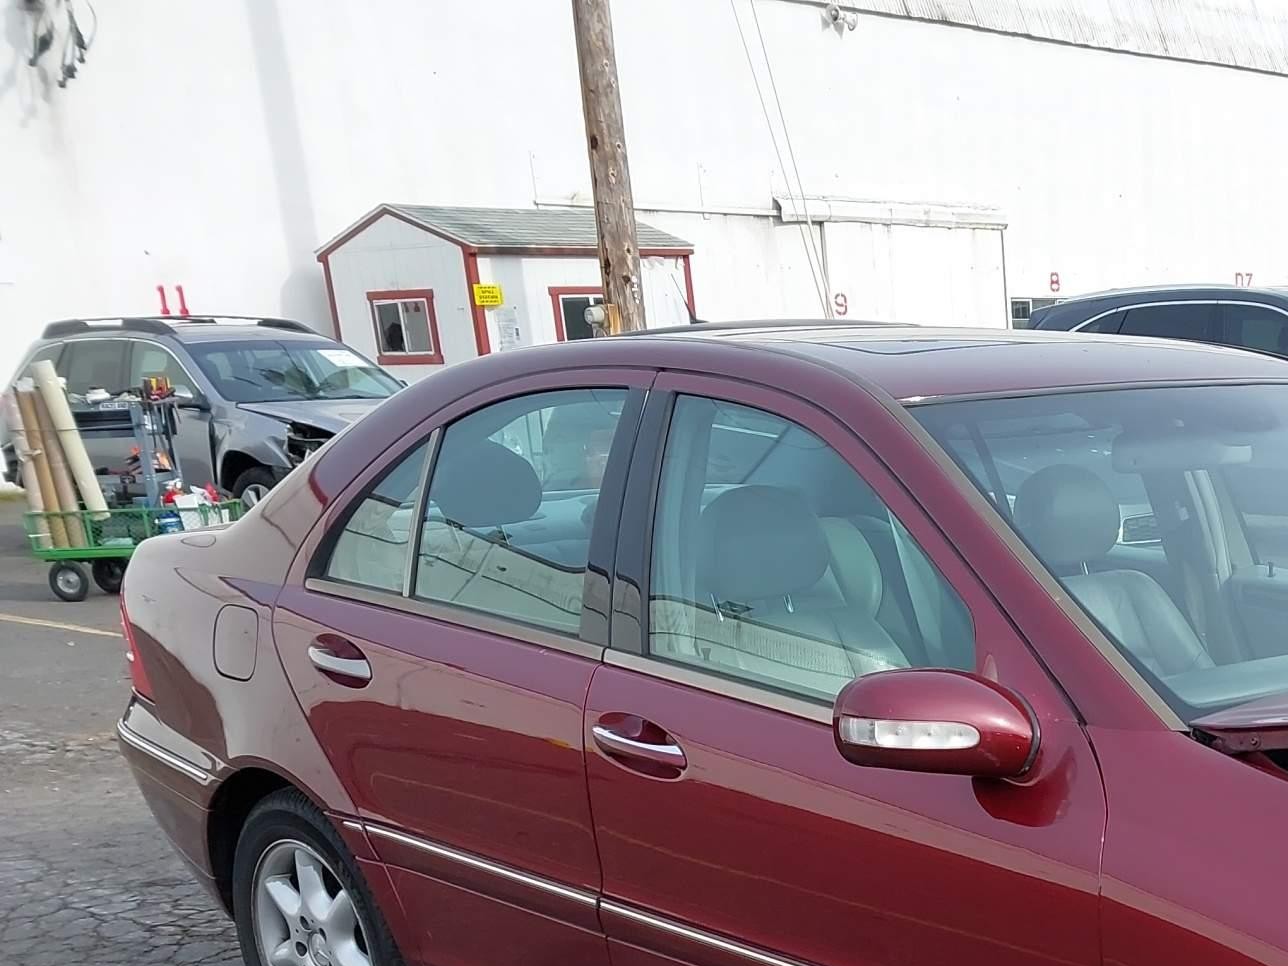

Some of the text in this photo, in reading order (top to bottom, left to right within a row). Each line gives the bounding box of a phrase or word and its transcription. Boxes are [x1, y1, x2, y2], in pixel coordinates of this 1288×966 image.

[1050, 272, 1060, 292] 8
[157, 285, 189, 317] 11
[834, 293, 848, 315] 9
